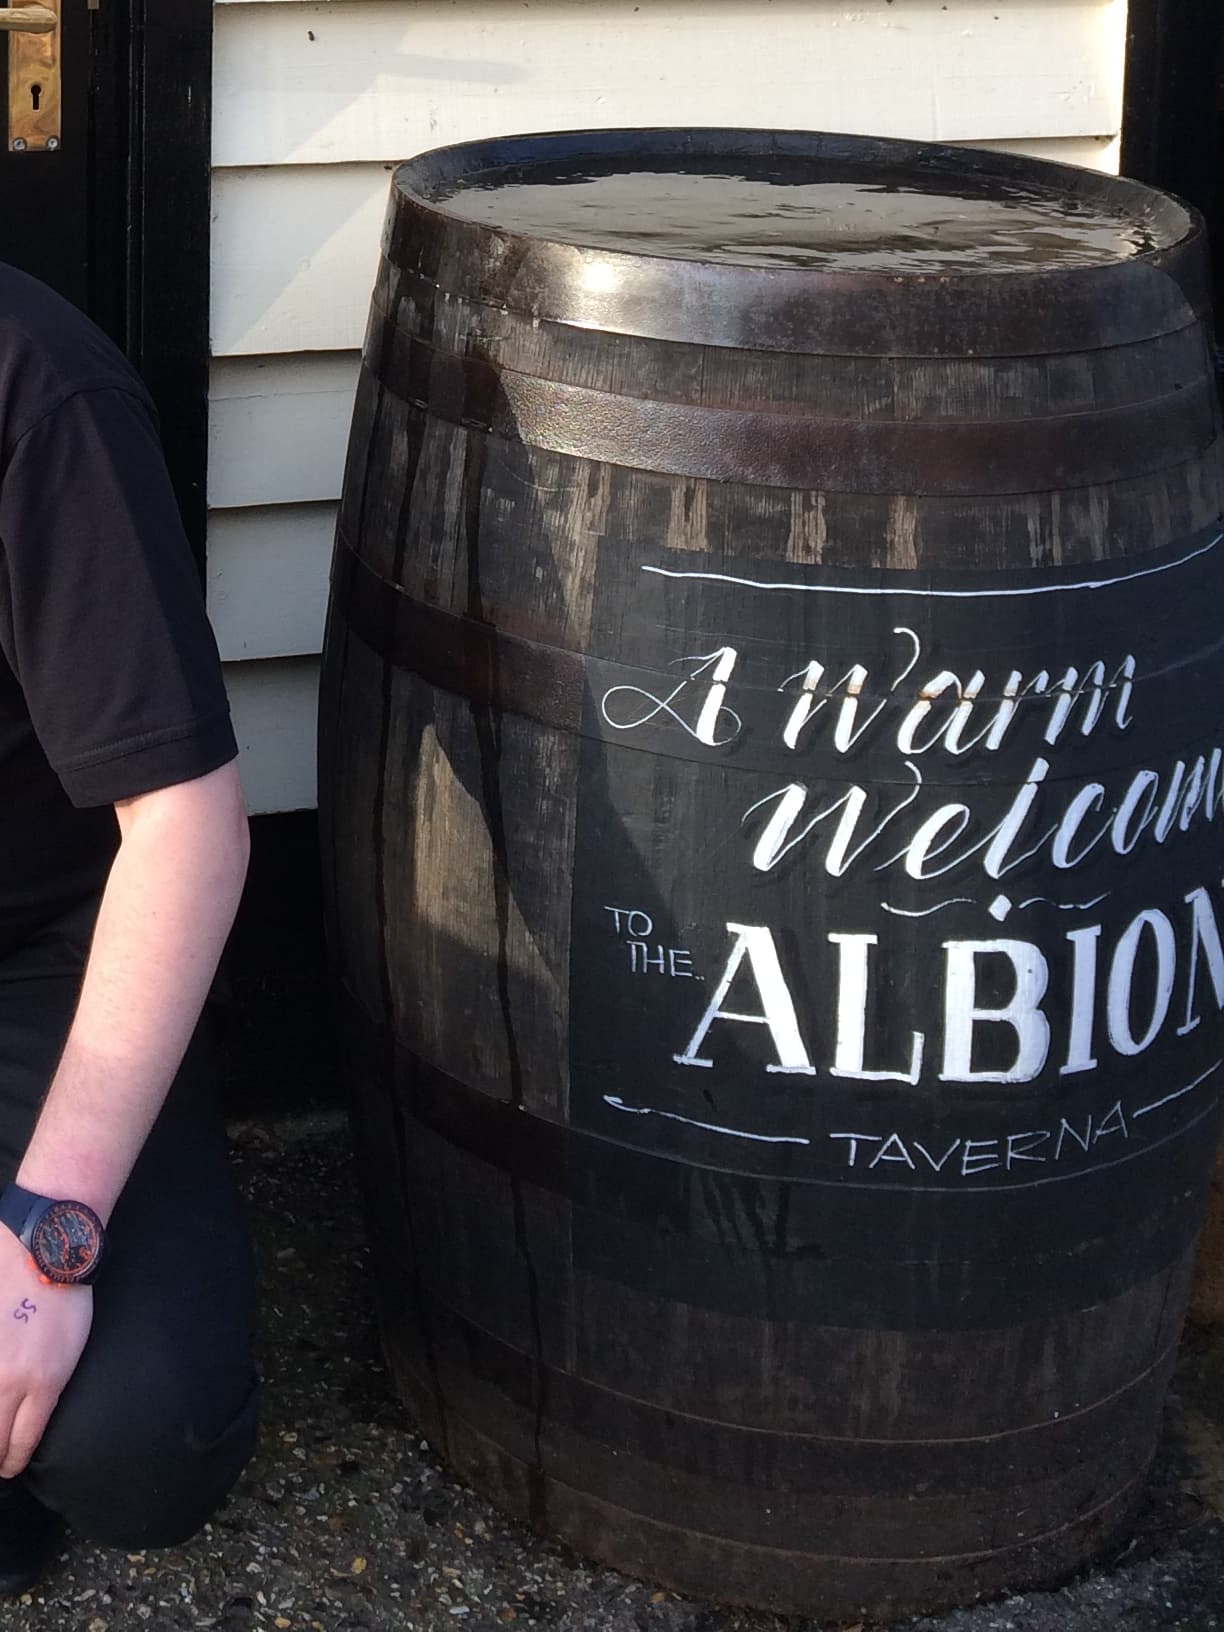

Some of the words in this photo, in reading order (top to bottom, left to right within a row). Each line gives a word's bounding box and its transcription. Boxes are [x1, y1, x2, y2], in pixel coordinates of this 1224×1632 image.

[601, 646, 742, 747] A
[603, 906, 654, 937] TO
[673, 885, 1224, 1086] ALBION
[829, 1099, 1129, 1177] TAVERNA
